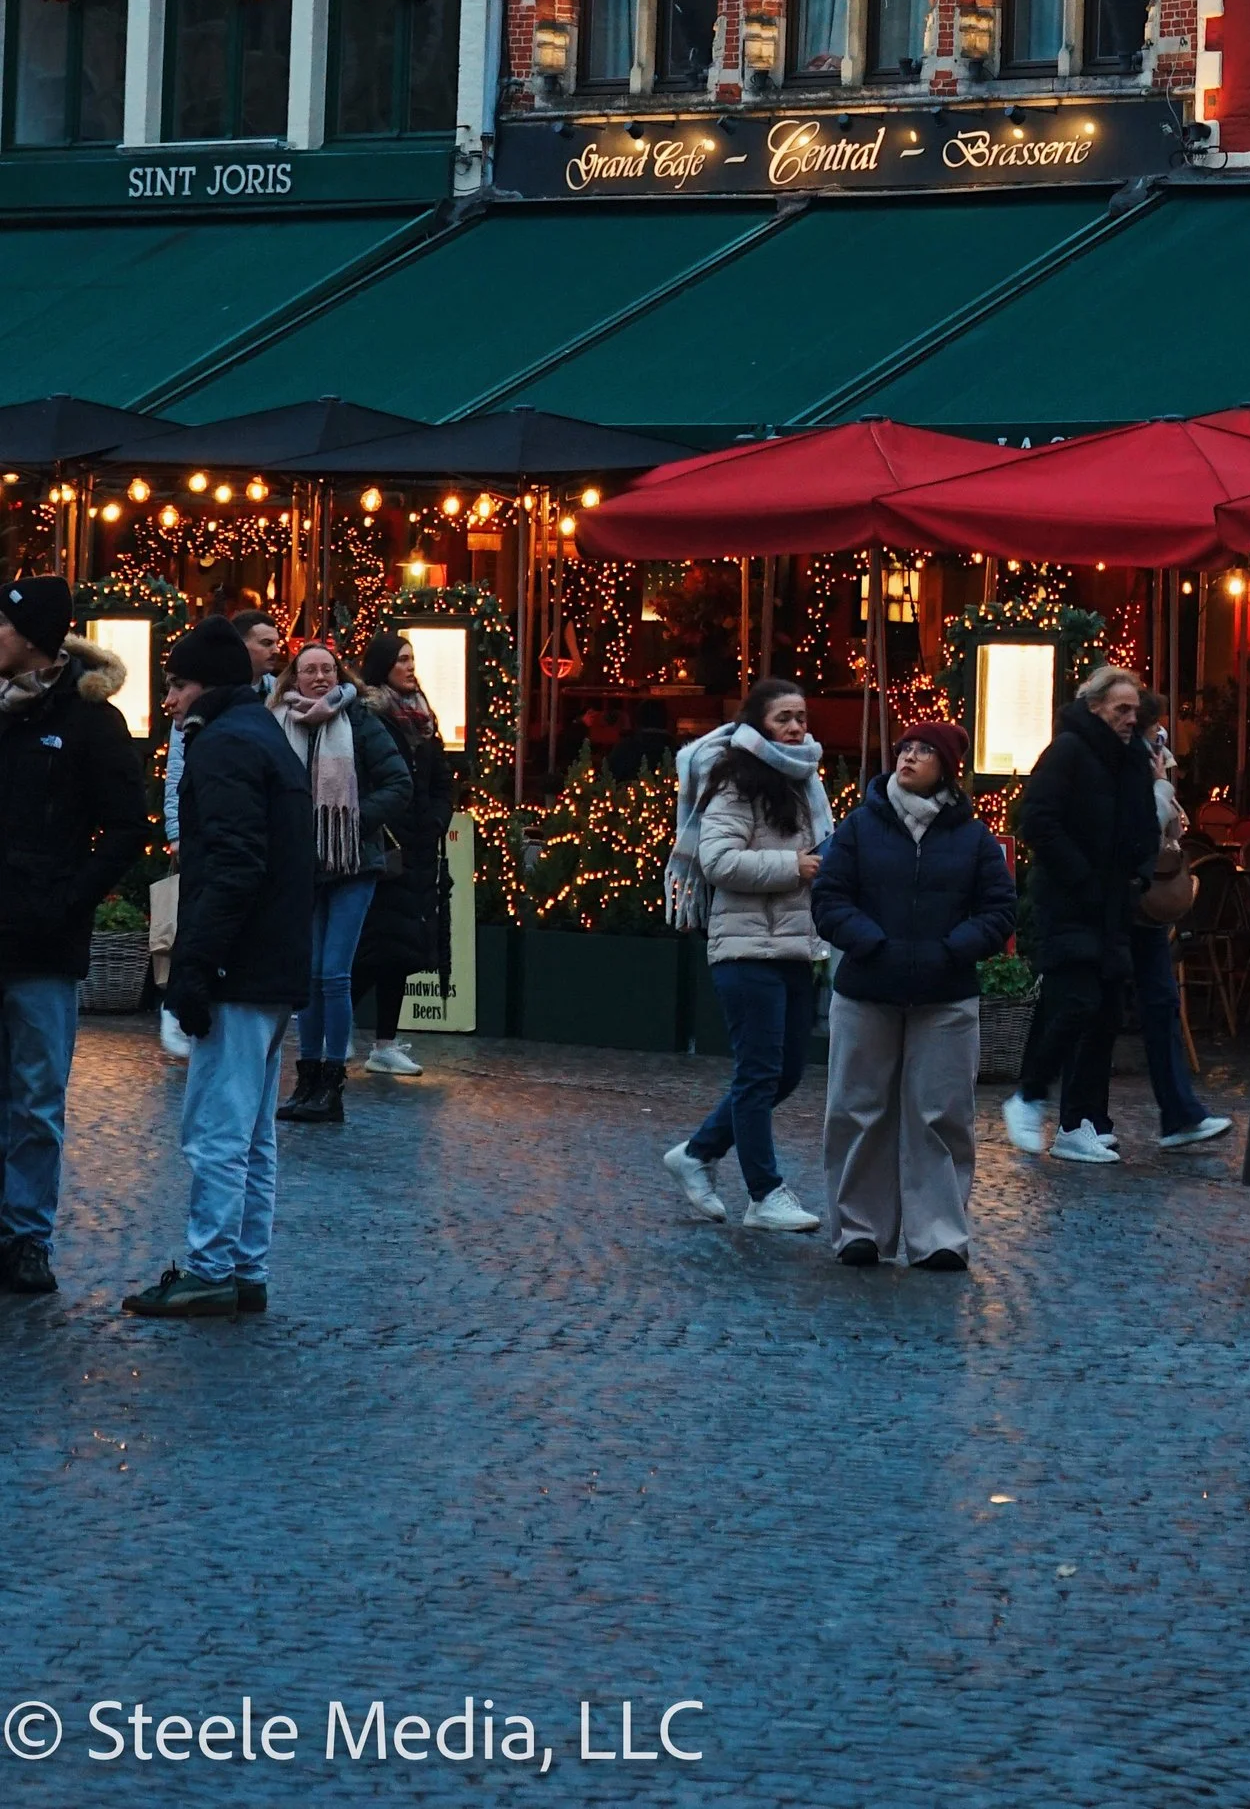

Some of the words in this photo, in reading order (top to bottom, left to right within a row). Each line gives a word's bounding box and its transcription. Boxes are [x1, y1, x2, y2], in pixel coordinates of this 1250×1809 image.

[566, 143, 650, 191] Grand
[767, 120, 886, 186] Central
[942, 130, 1093, 169] Brasserie
[128, 166, 196, 197] SINT
[206, 164, 292, 195] JORIS
[412, 1002, 442, 1020] Beers
